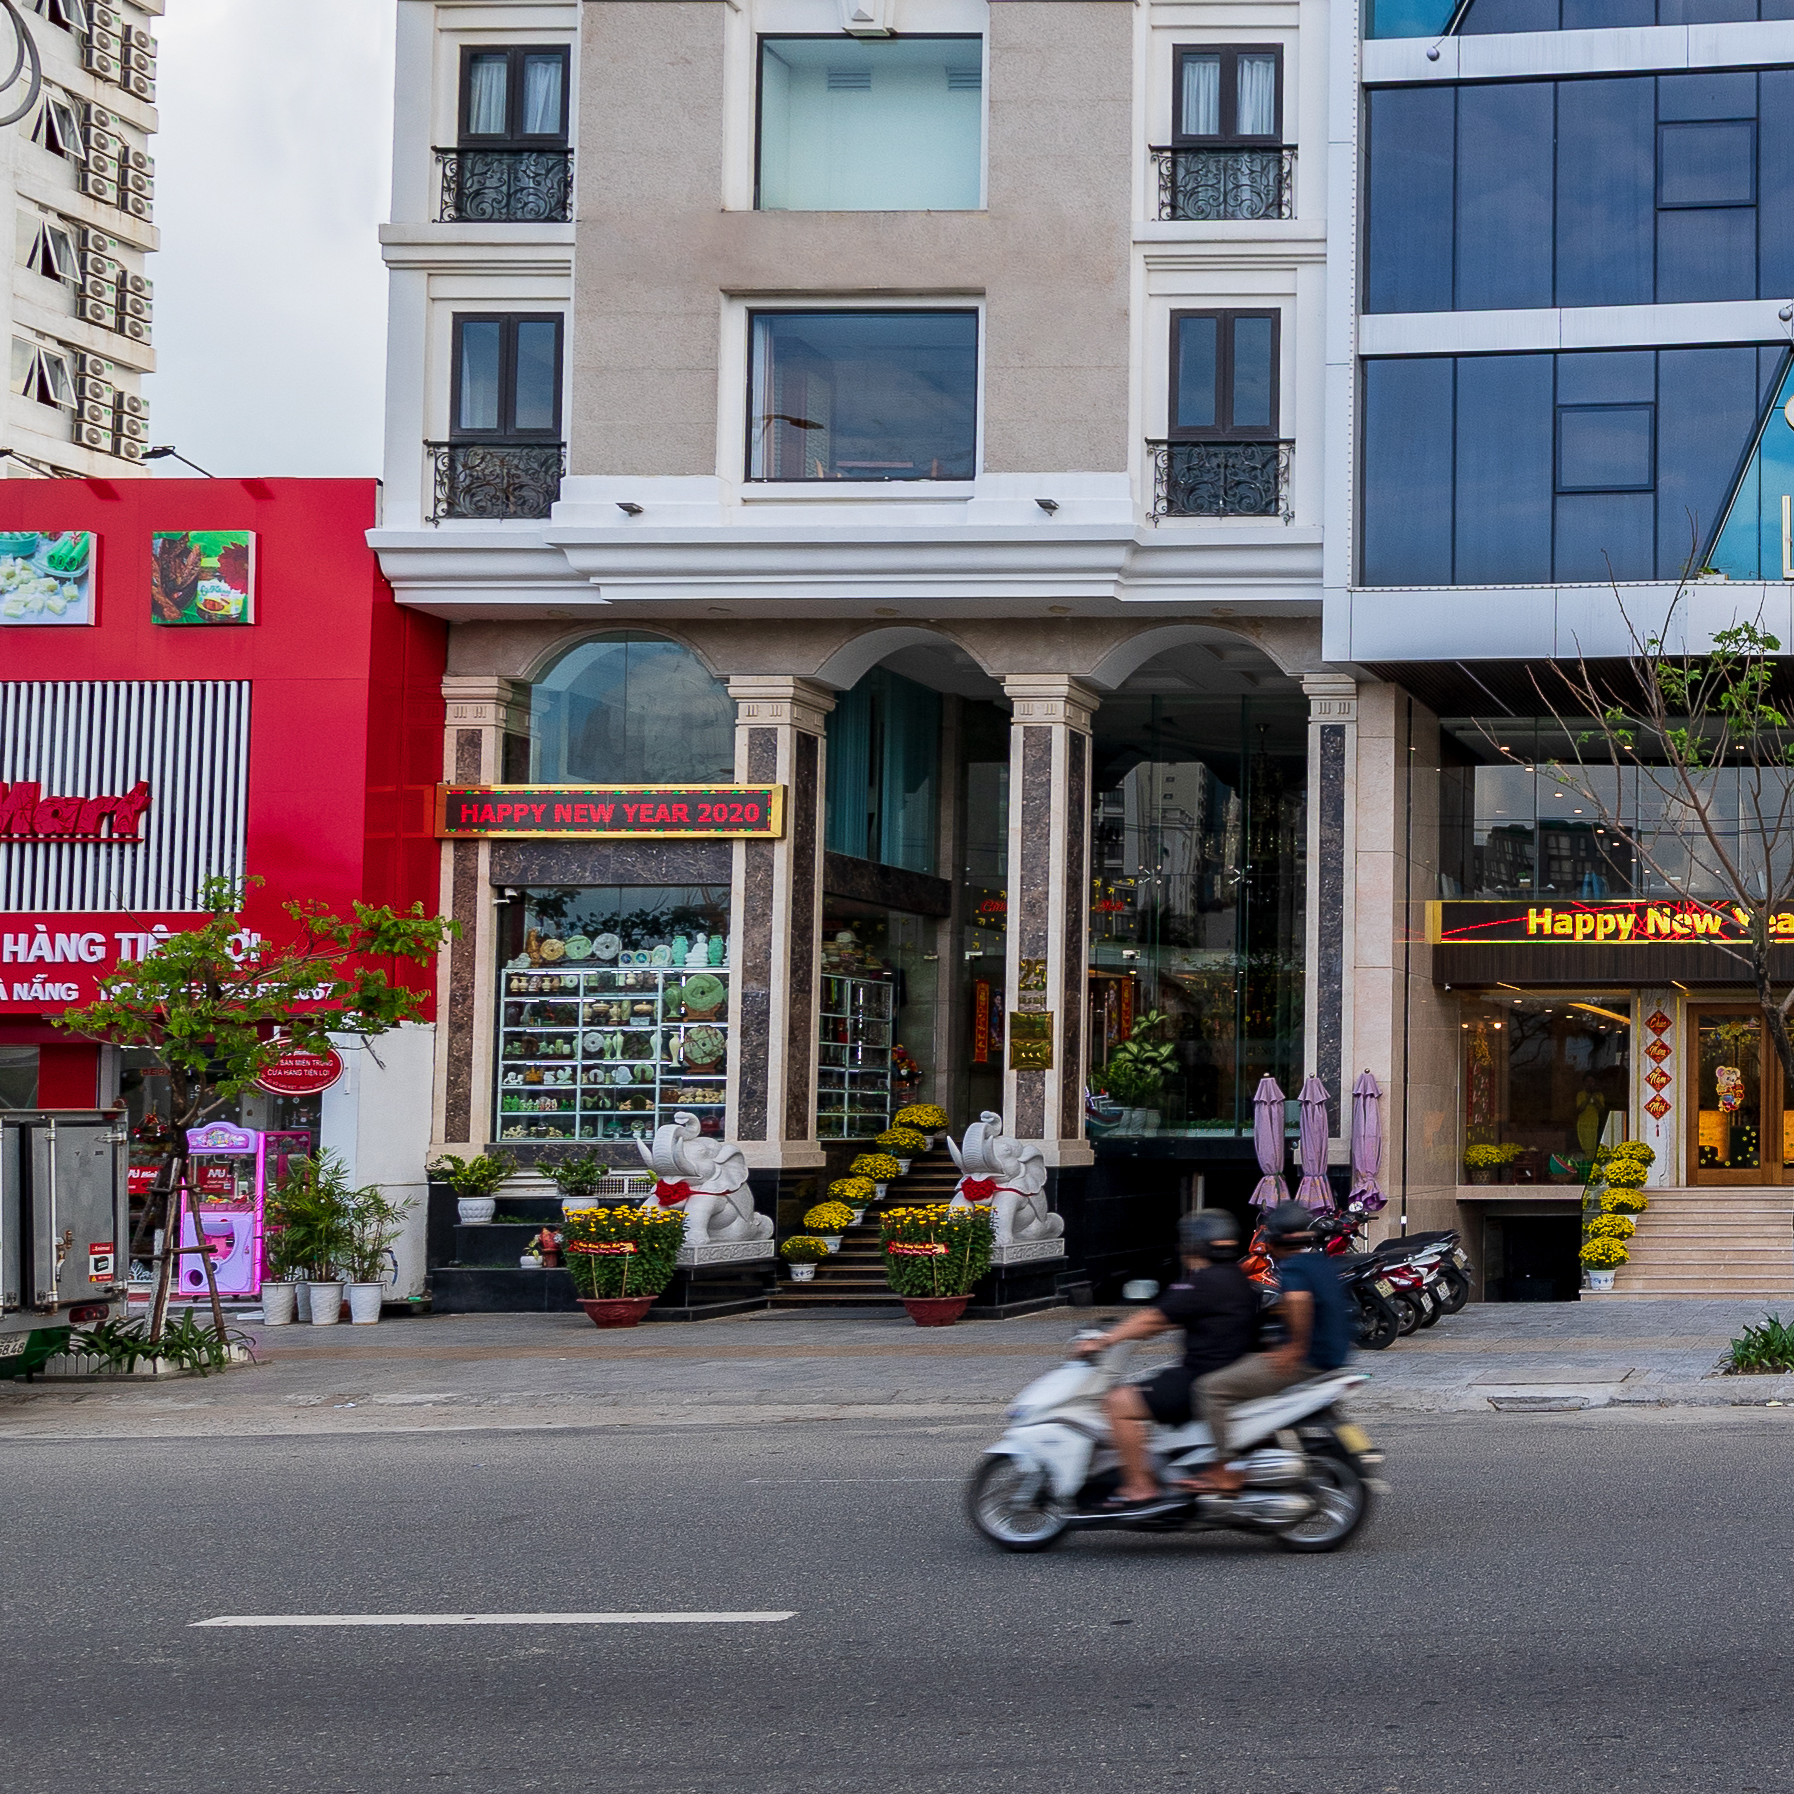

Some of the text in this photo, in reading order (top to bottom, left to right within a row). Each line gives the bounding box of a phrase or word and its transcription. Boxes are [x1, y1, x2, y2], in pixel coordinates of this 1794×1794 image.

[460, 803, 760, 824] HAPPY NEW YEAR 2020
[1527, 907, 1636, 940] Happy
[1646, 907, 1722, 935] New
[2, 923, 107, 963] HÀNG
[12, 973, 80, 1001] NẴNG
